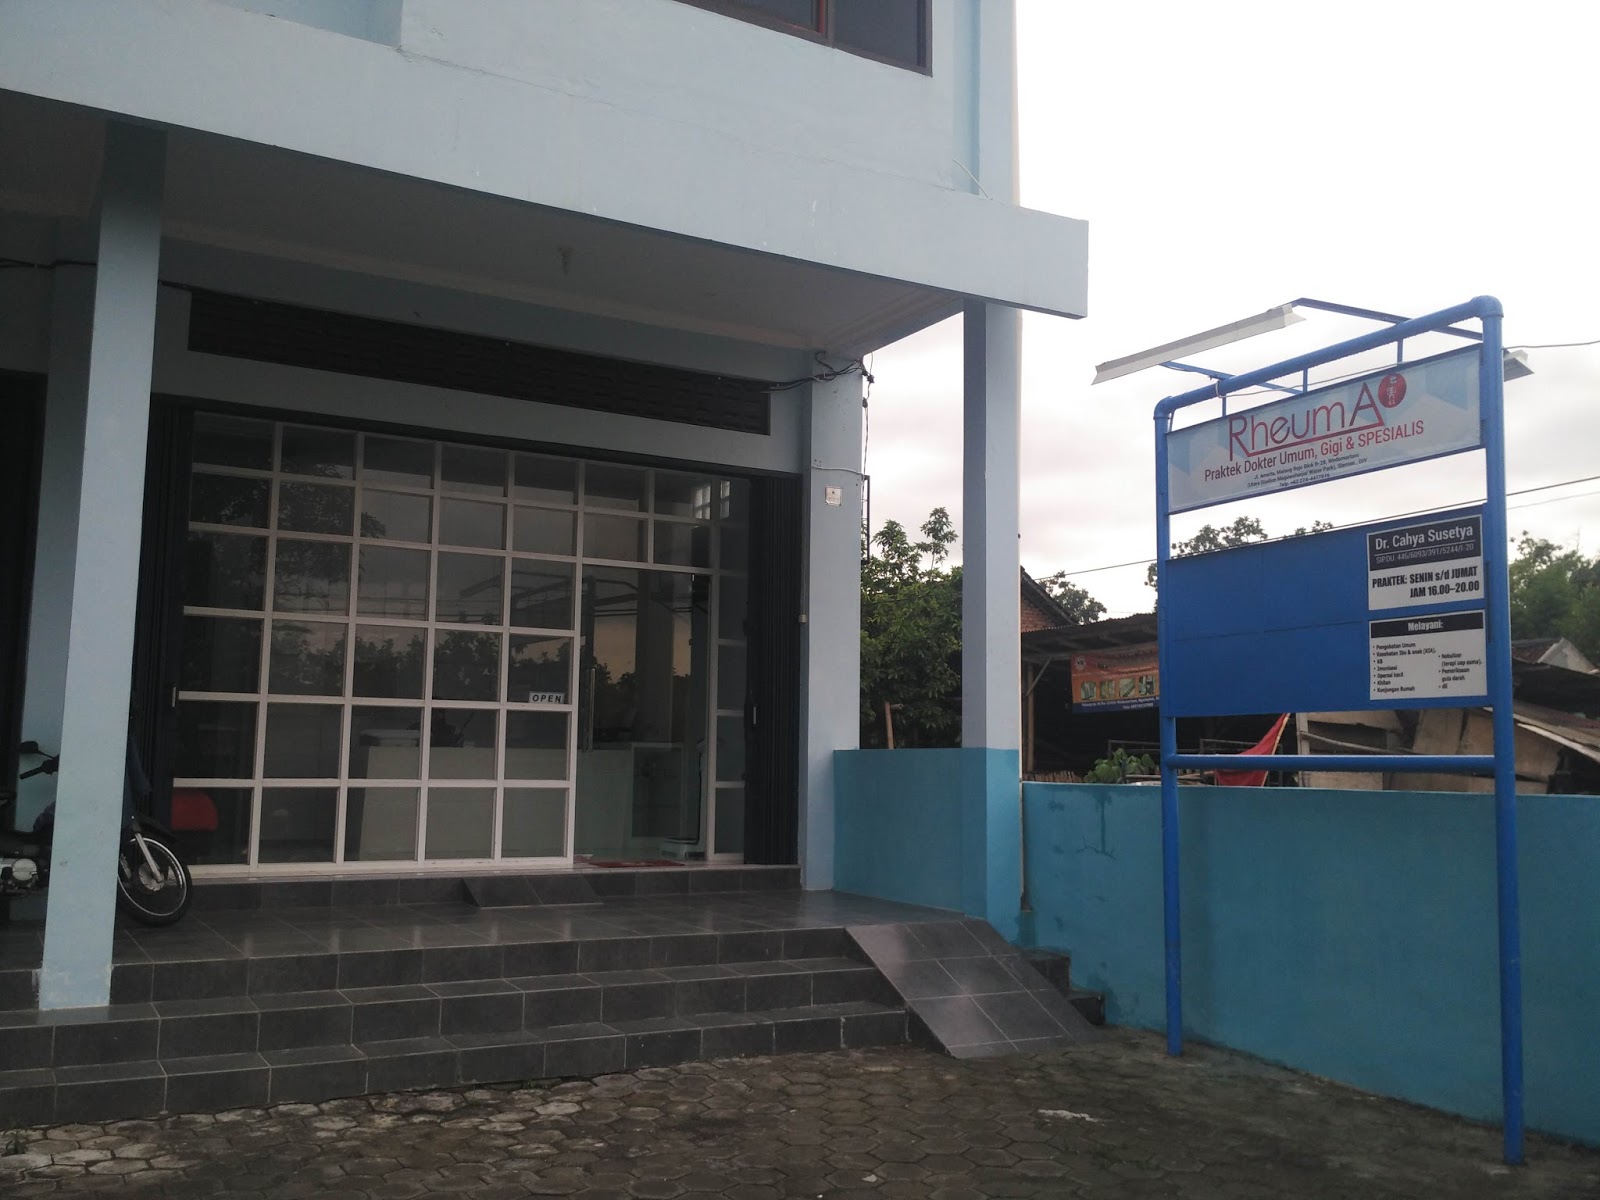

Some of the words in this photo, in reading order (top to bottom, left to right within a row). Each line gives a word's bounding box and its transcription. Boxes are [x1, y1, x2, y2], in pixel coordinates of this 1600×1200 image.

[1228, 381, 1385, 462] RheumA
[1204, 461, 1242, 482] Praktek
[1244, 455, 1277, 473] Dokter
[1279, 447, 1318, 465] Umum,
[1320, 438, 1343, 457] Gigi
[1346, 436, 1355, 450] &
[1358, 420, 1425, 447] SPESIALIS
[1375, 537, 1390, 550] Dr.
[1392, 532, 1425, 548] Cahya
[1428, 525, 1474, 542] Susetya
[1372, 574, 1408, 588] PRAKTEK:
[1410, 571, 1434, 584] SENIN
[1435, 569, 1450, 581] s/d
[1451, 566, 1478, 579] JUMAT
[1410, 587, 1426, 598] JAM
[1408, 620, 1444, 632] Melayani:
[532, 694, 562, 703] OPEN
